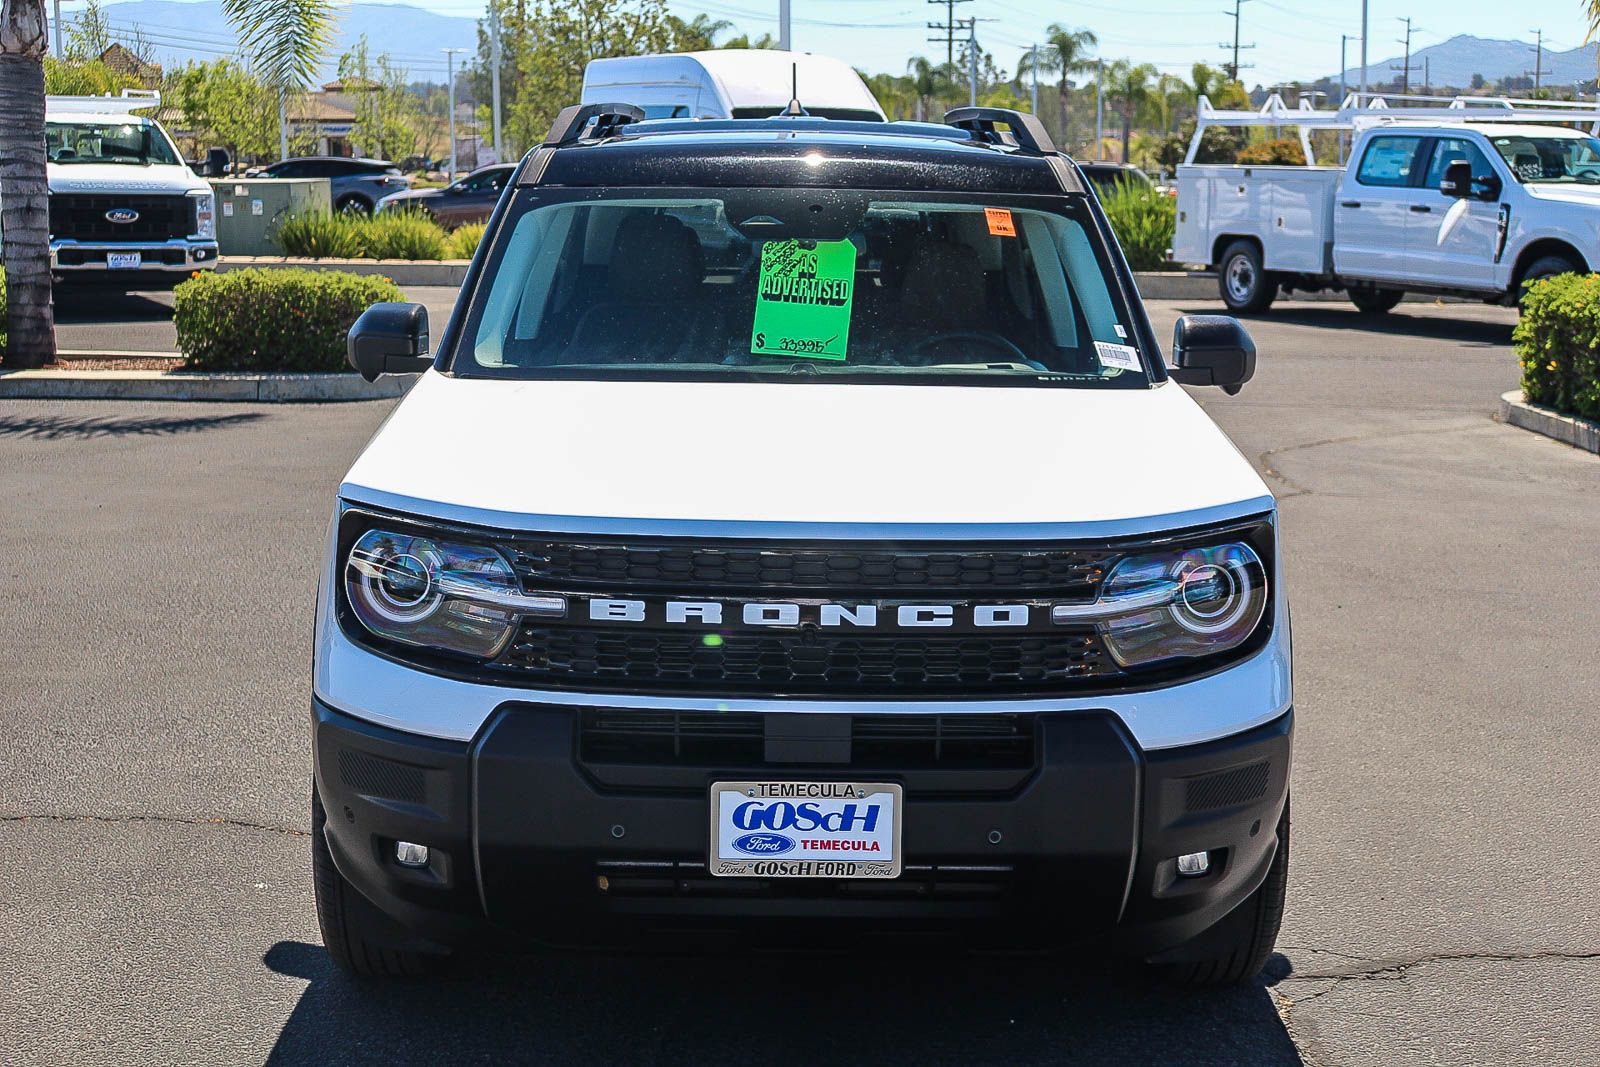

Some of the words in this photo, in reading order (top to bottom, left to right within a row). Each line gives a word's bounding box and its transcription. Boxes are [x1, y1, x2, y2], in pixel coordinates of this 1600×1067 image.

[761, 275, 849, 306] ADVERTISED
[589, 599, 1029, 627] BRONCO
[758, 783, 855, 798] TEMECULA
[746, 837, 781, 851] Ford
[801, 839, 880, 852] TEMECULA
[718, 862, 747, 874] Ford
[815, 862, 857, 876] FORD
[864, 864, 893, 876] Ford
